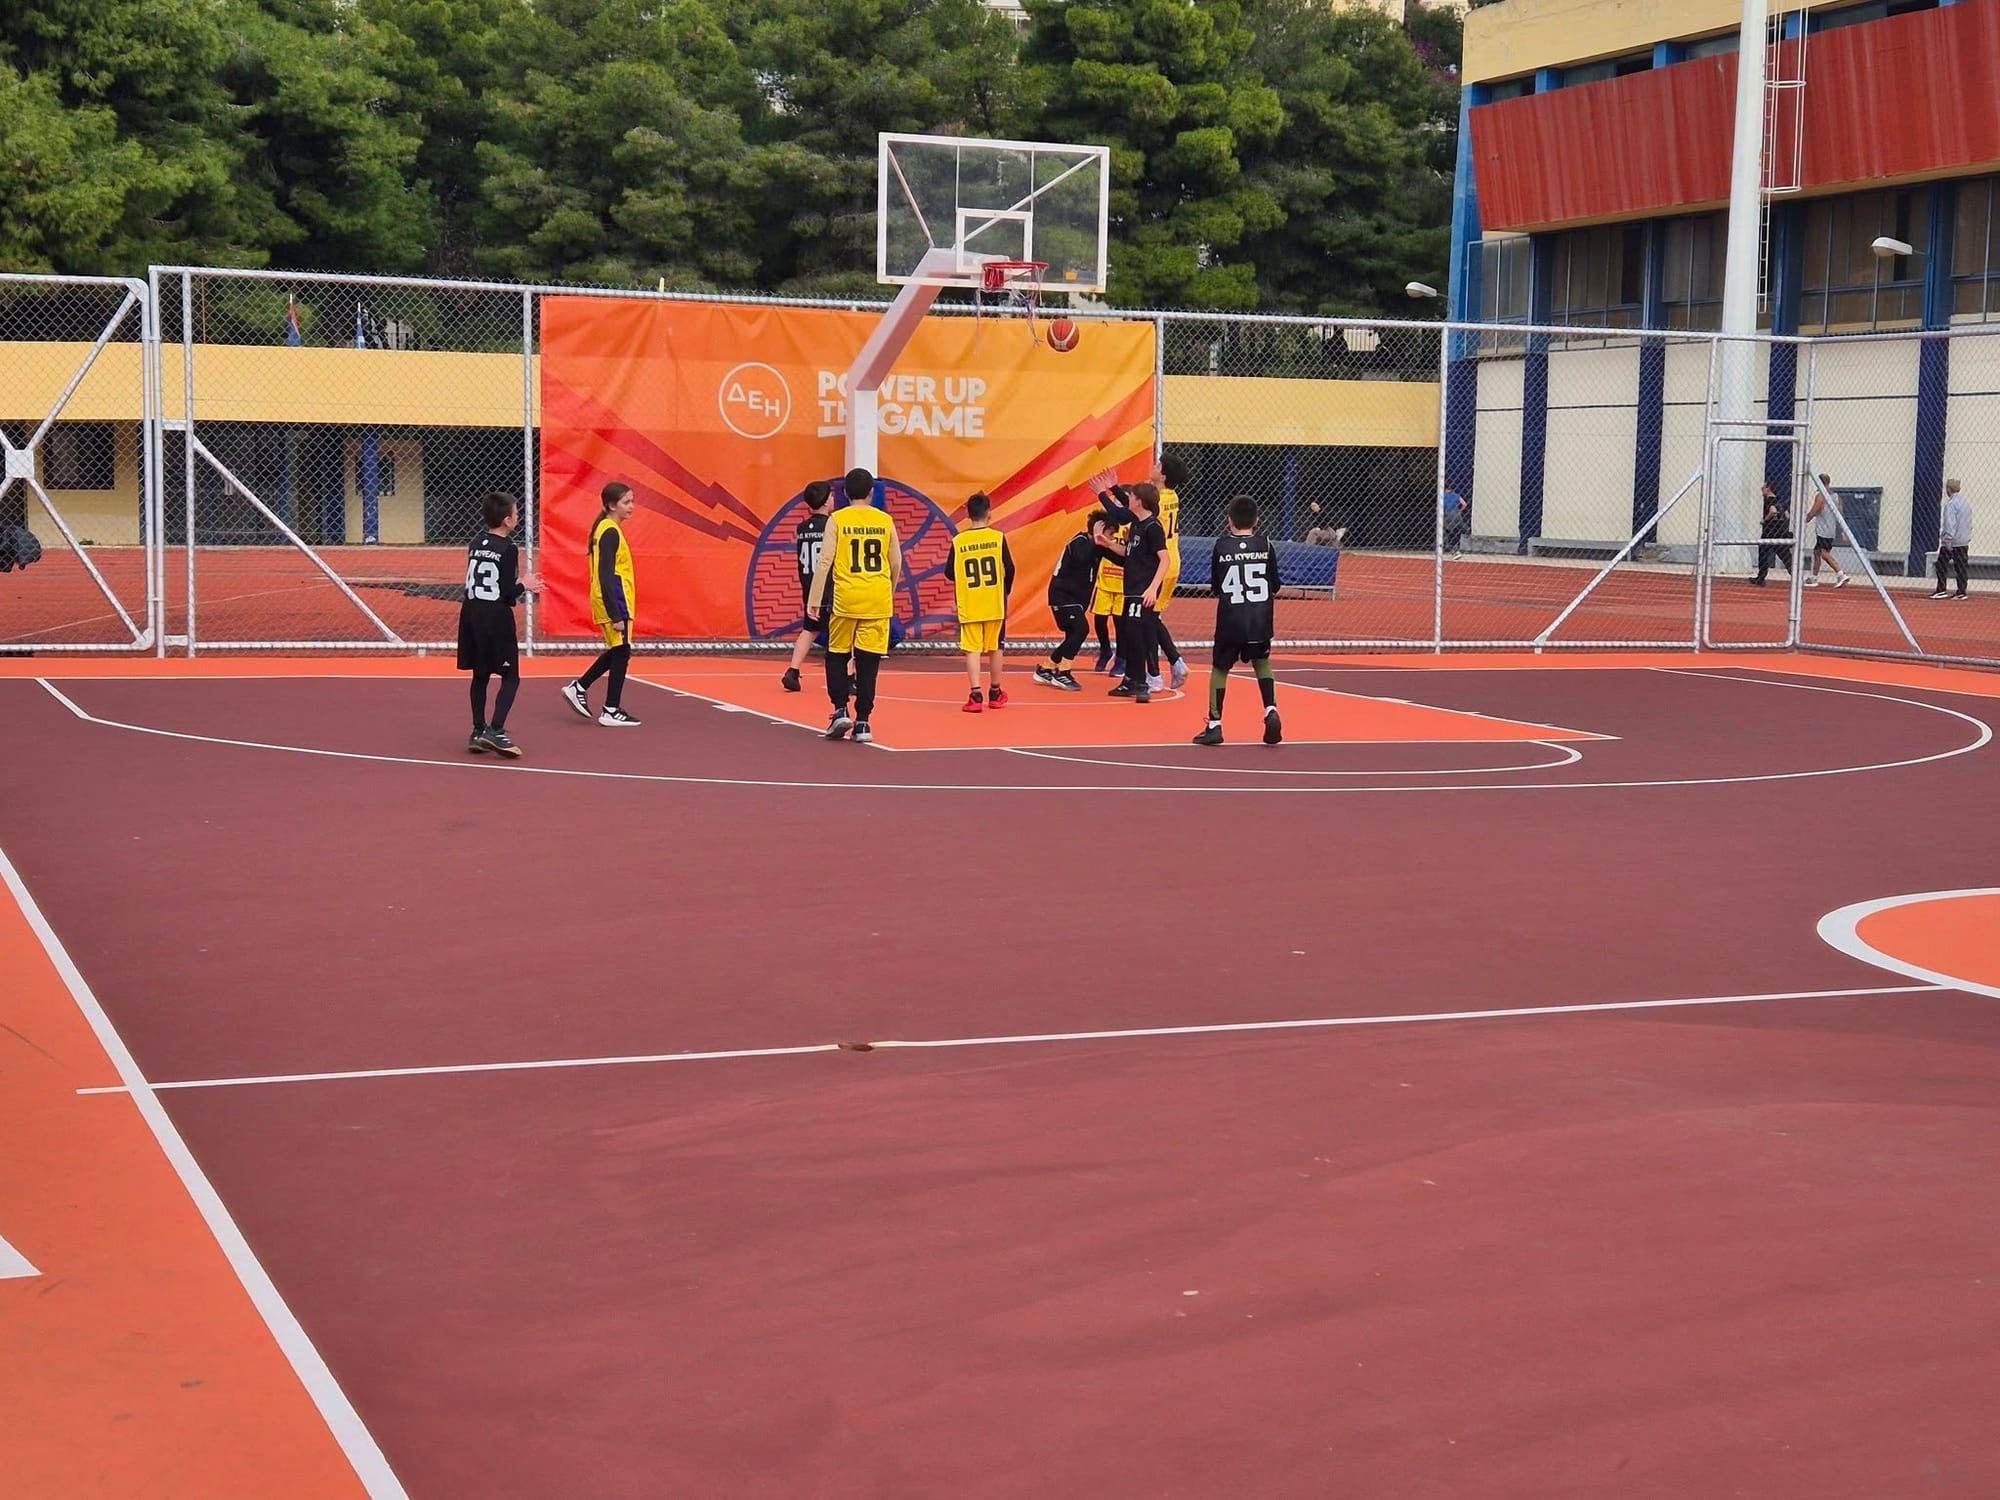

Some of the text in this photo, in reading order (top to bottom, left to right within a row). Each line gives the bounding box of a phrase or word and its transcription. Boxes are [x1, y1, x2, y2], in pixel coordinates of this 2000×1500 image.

[727, 382, 781, 418] ΔΕΗ
[944, 375, 986, 405] UP
[877, 402, 985, 438] GAME
[849, 538, 882, 573] 18
[964, 555, 998, 589] 99
[1221, 563, 1269, 605] 45
